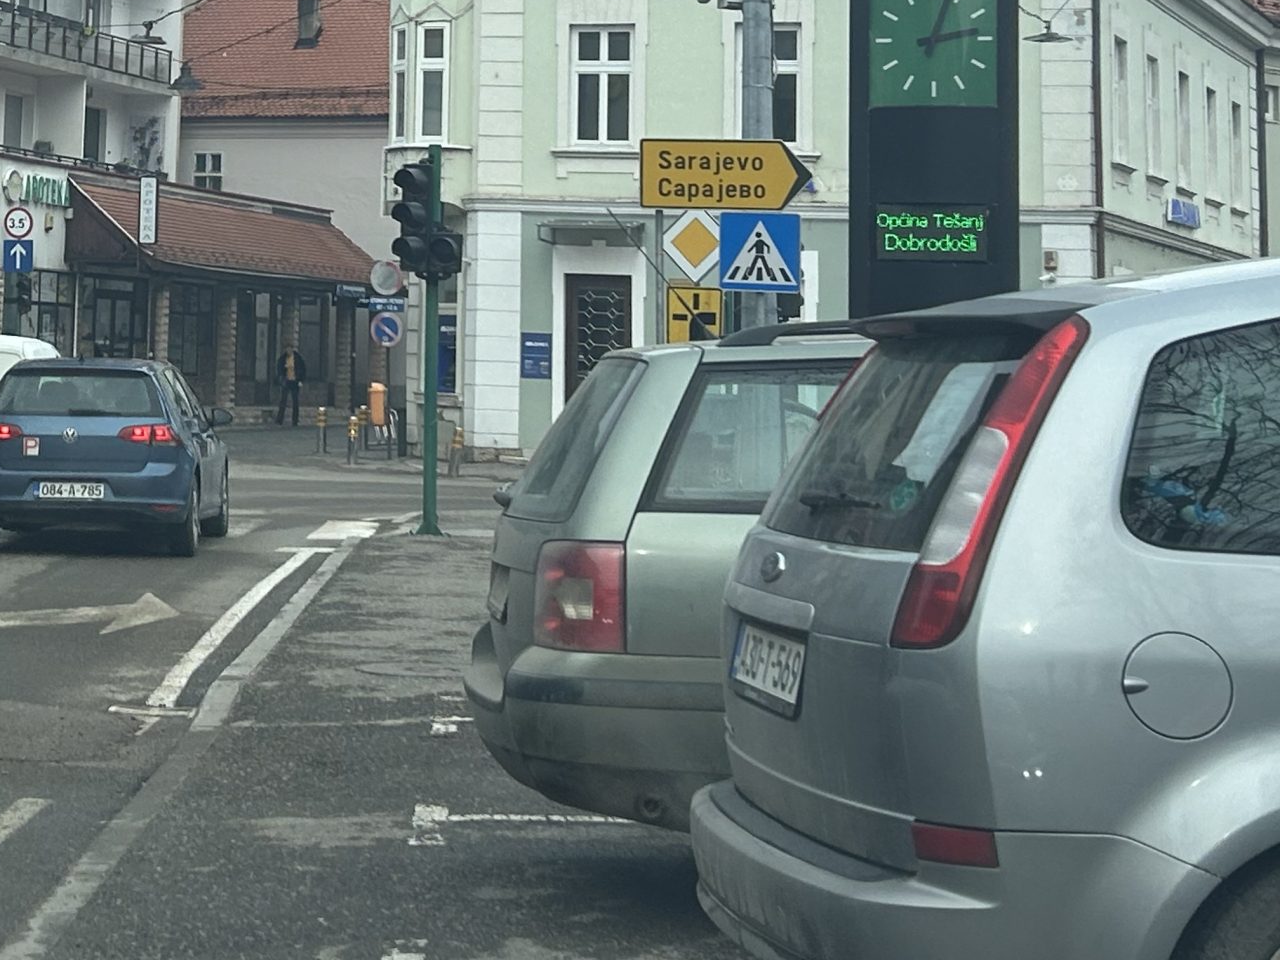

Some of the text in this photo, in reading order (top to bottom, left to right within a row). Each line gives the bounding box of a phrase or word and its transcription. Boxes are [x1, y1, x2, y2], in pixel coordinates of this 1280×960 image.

[658, 150, 764, 175] Sarajevo
[658, 177, 766, 203] Сарајево
[142, 181, 154, 241] APOTEKA
[932, 212, 984, 232] Tešanj
[41, 483, 102, 497] 084-A-785
